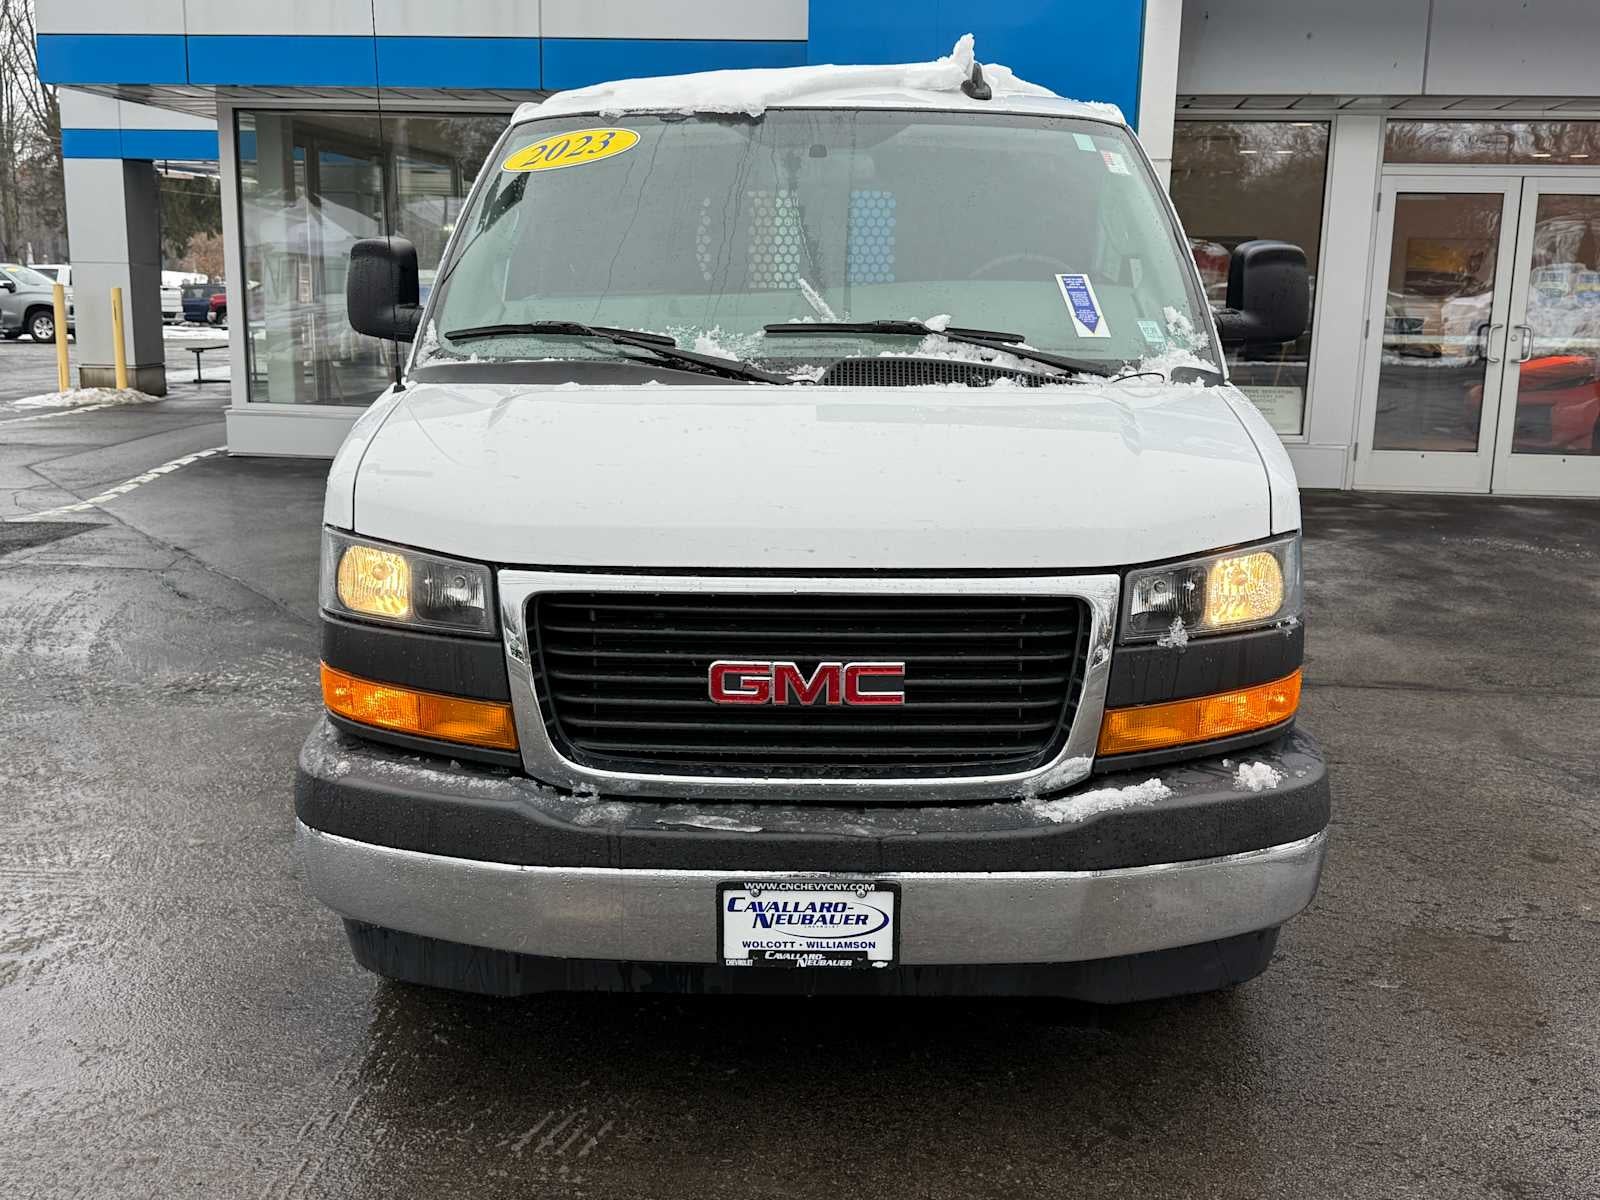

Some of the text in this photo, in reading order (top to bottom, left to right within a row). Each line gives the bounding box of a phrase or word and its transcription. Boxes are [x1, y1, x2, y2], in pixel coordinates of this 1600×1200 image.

[520, 132, 616, 167] 2023
[708, 660, 905, 706] GMC
[744, 882, 875, 891] WWW.CNCHEVYCNY.COM
[752, 913, 869, 929] NEUBAUER
[742, 941, 876, 949] WOLCOTT WILLIAMSON
[796, 958, 853, 968] NEUBAUER
